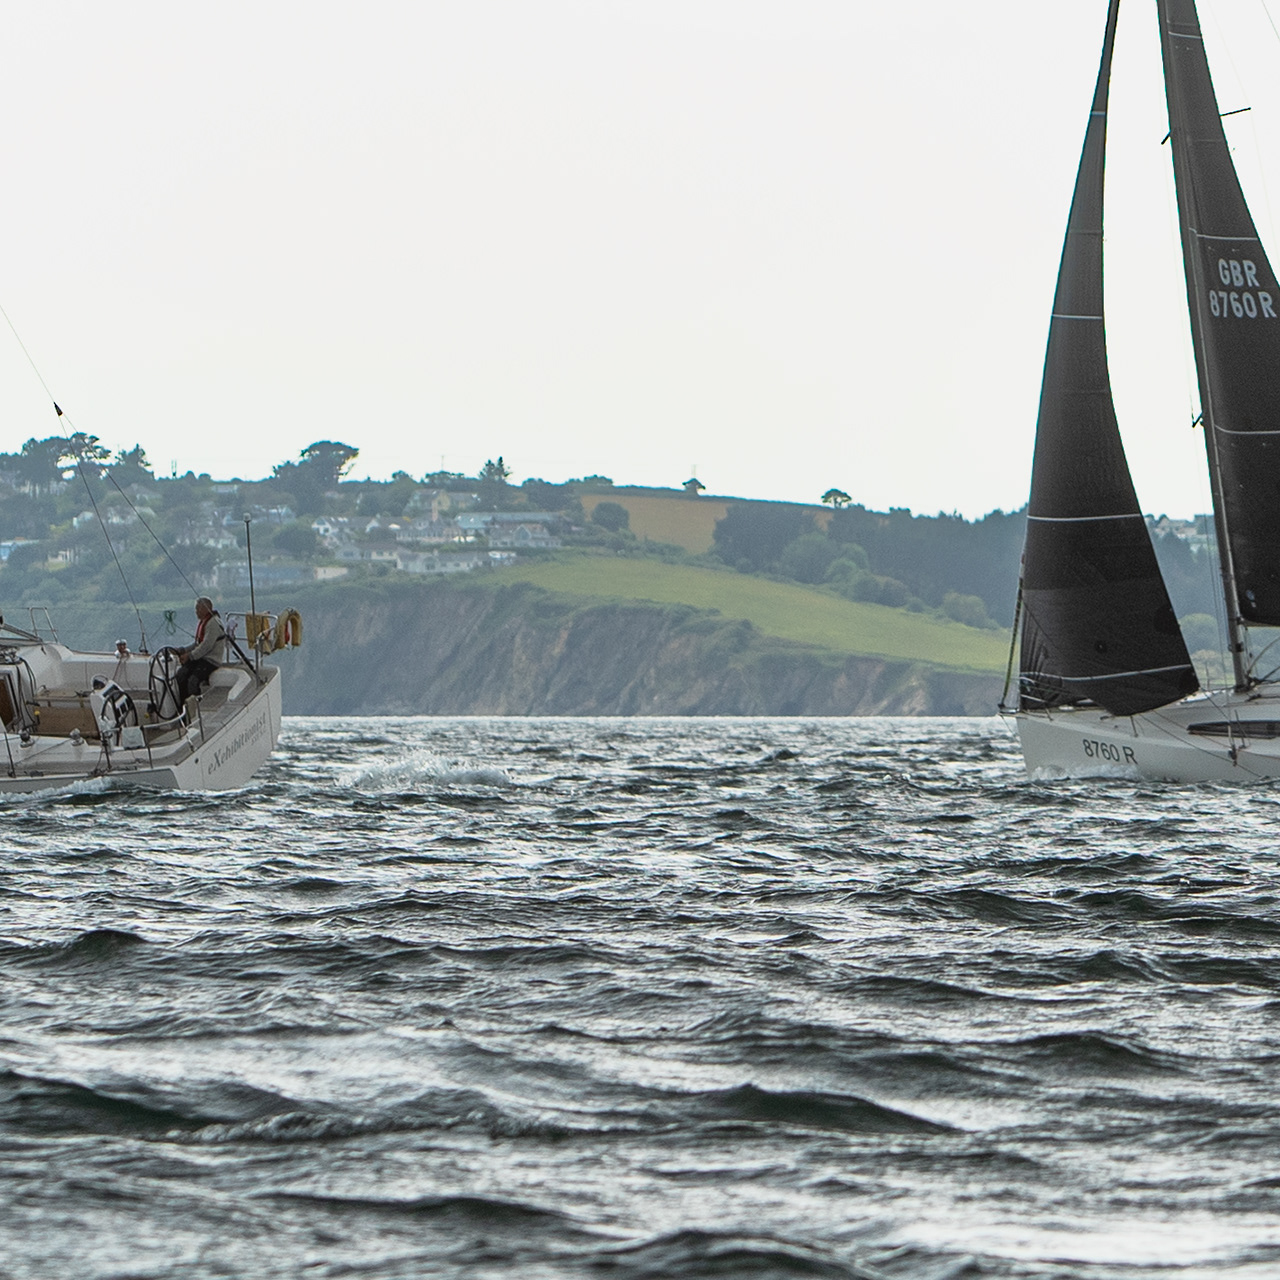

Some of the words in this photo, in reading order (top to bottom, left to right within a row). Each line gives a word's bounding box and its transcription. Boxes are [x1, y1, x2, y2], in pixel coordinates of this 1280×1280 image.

[1218, 258, 1260, 288] GBR
[1083, 739, 1120, 762] 8760
[1122, 745, 1138, 765] R
